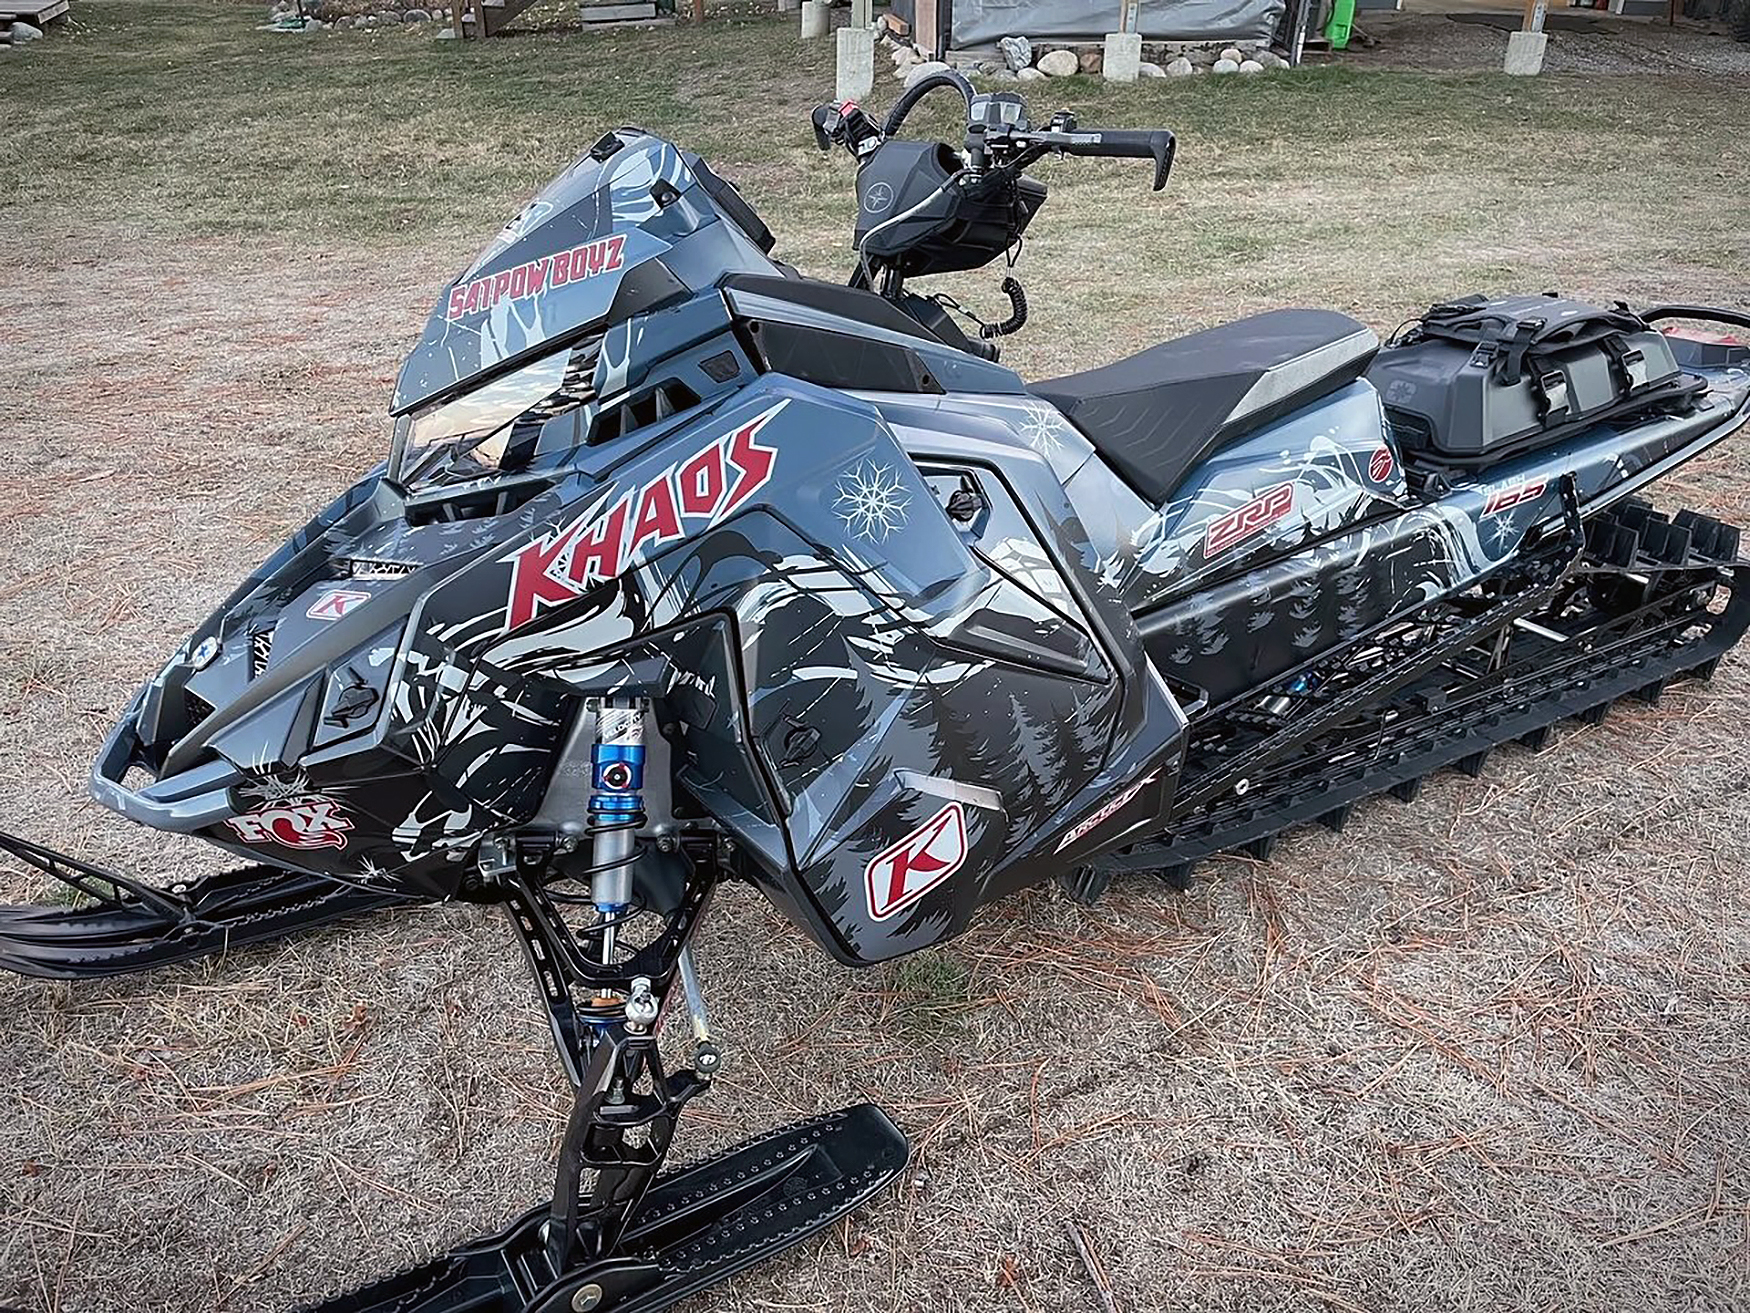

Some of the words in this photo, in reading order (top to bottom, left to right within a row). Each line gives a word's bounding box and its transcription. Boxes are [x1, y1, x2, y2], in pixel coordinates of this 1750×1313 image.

[550, 234, 627, 289] BOYZ
[497, 399, 778, 637] KHAOS
[1207, 485, 1293, 548] ZRP
[1479, 474, 1548, 519] 165
[225, 801, 355, 850] FOX
